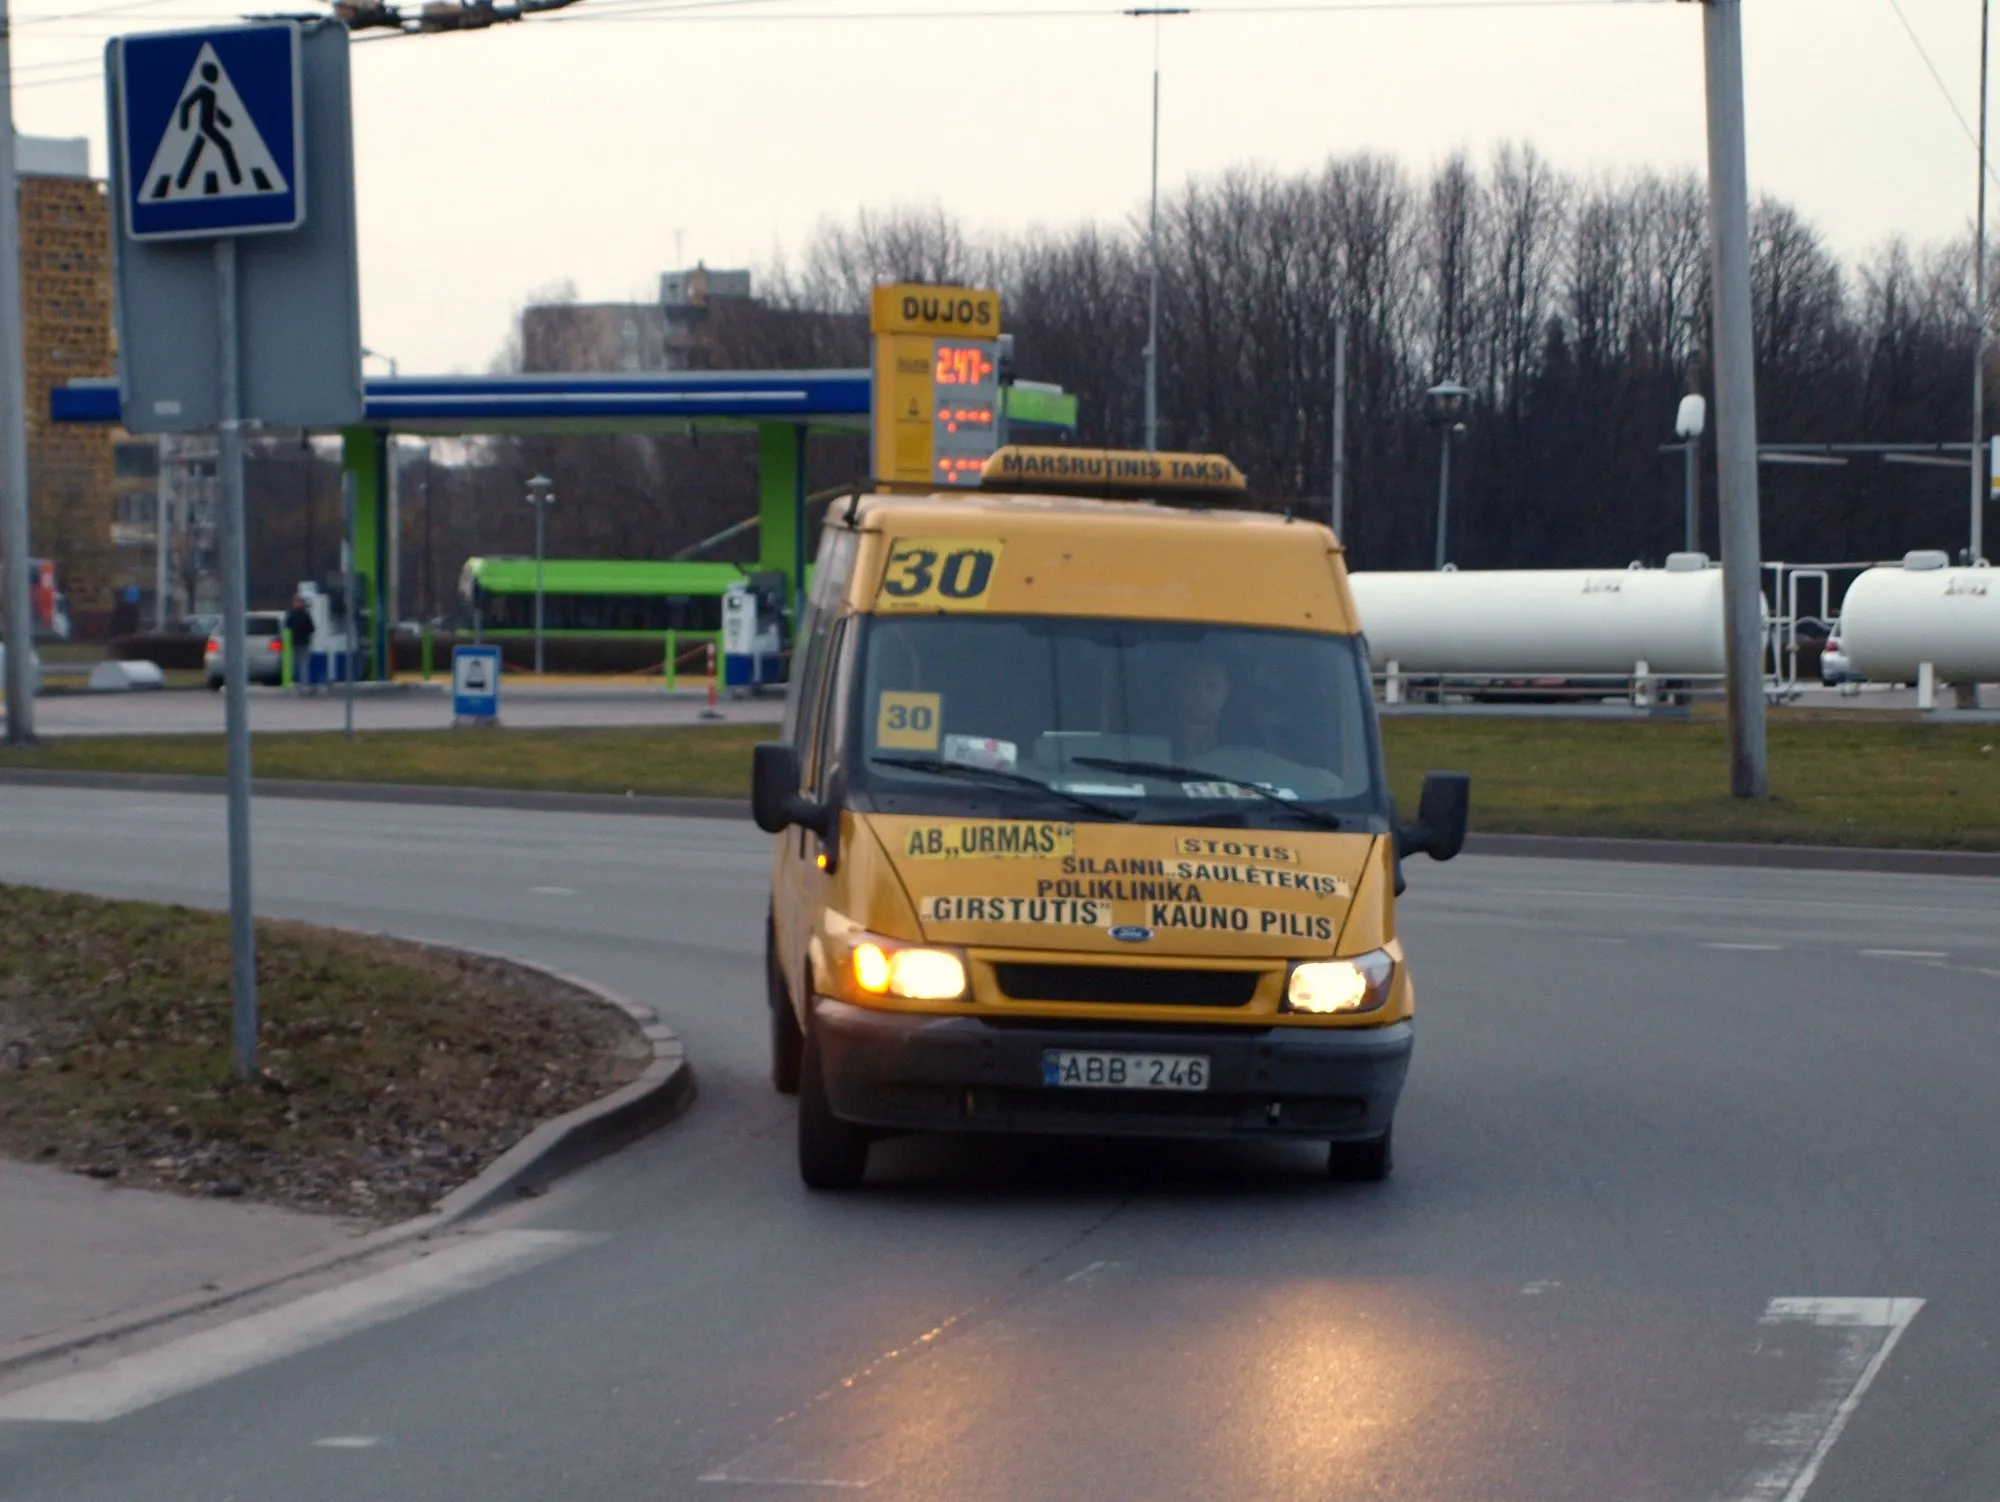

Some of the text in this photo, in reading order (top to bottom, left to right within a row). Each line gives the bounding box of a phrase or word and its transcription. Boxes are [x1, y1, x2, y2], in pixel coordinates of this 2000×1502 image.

[903, 296, 991, 325] DUJOS
[1171, 461, 1232, 481] TAKSI
[883, 548, 995, 599] 30
[887, 704, 932, 731] 30
[1184, 838, 1290, 861] STOTIS
[1037, 879, 1202, 903] POLIKLINIKA
[1152, 903, 1249, 931] KAUNO
[1260, 910, 1332, 940] PILIS
[1063, 1056, 1128, 1084] ABB
[1149, 1059, 1204, 1087] 246
